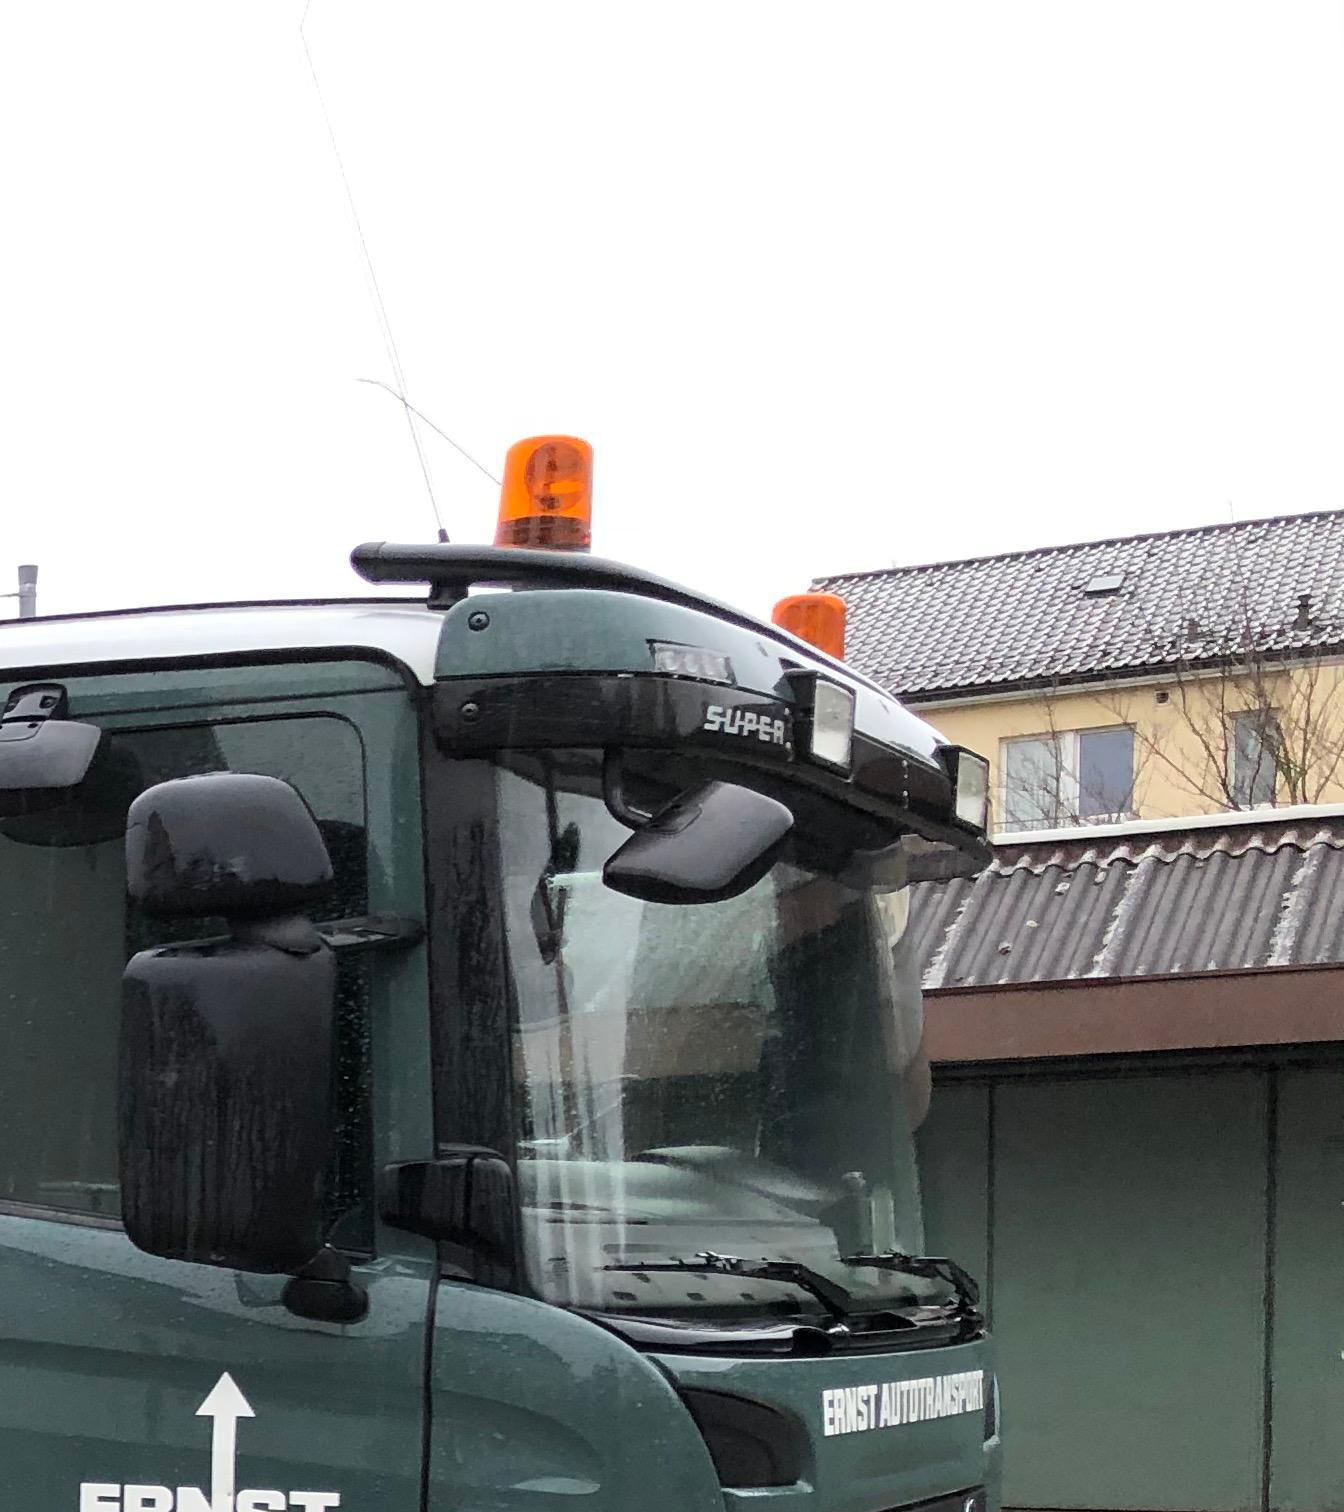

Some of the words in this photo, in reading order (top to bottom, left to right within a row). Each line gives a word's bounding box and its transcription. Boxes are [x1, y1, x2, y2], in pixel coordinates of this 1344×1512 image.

[703, 704, 785, 745] SUPER
[822, 1384, 878, 1437] ERNST
[878, 1369, 984, 1428] AUTOTRANSPORT
